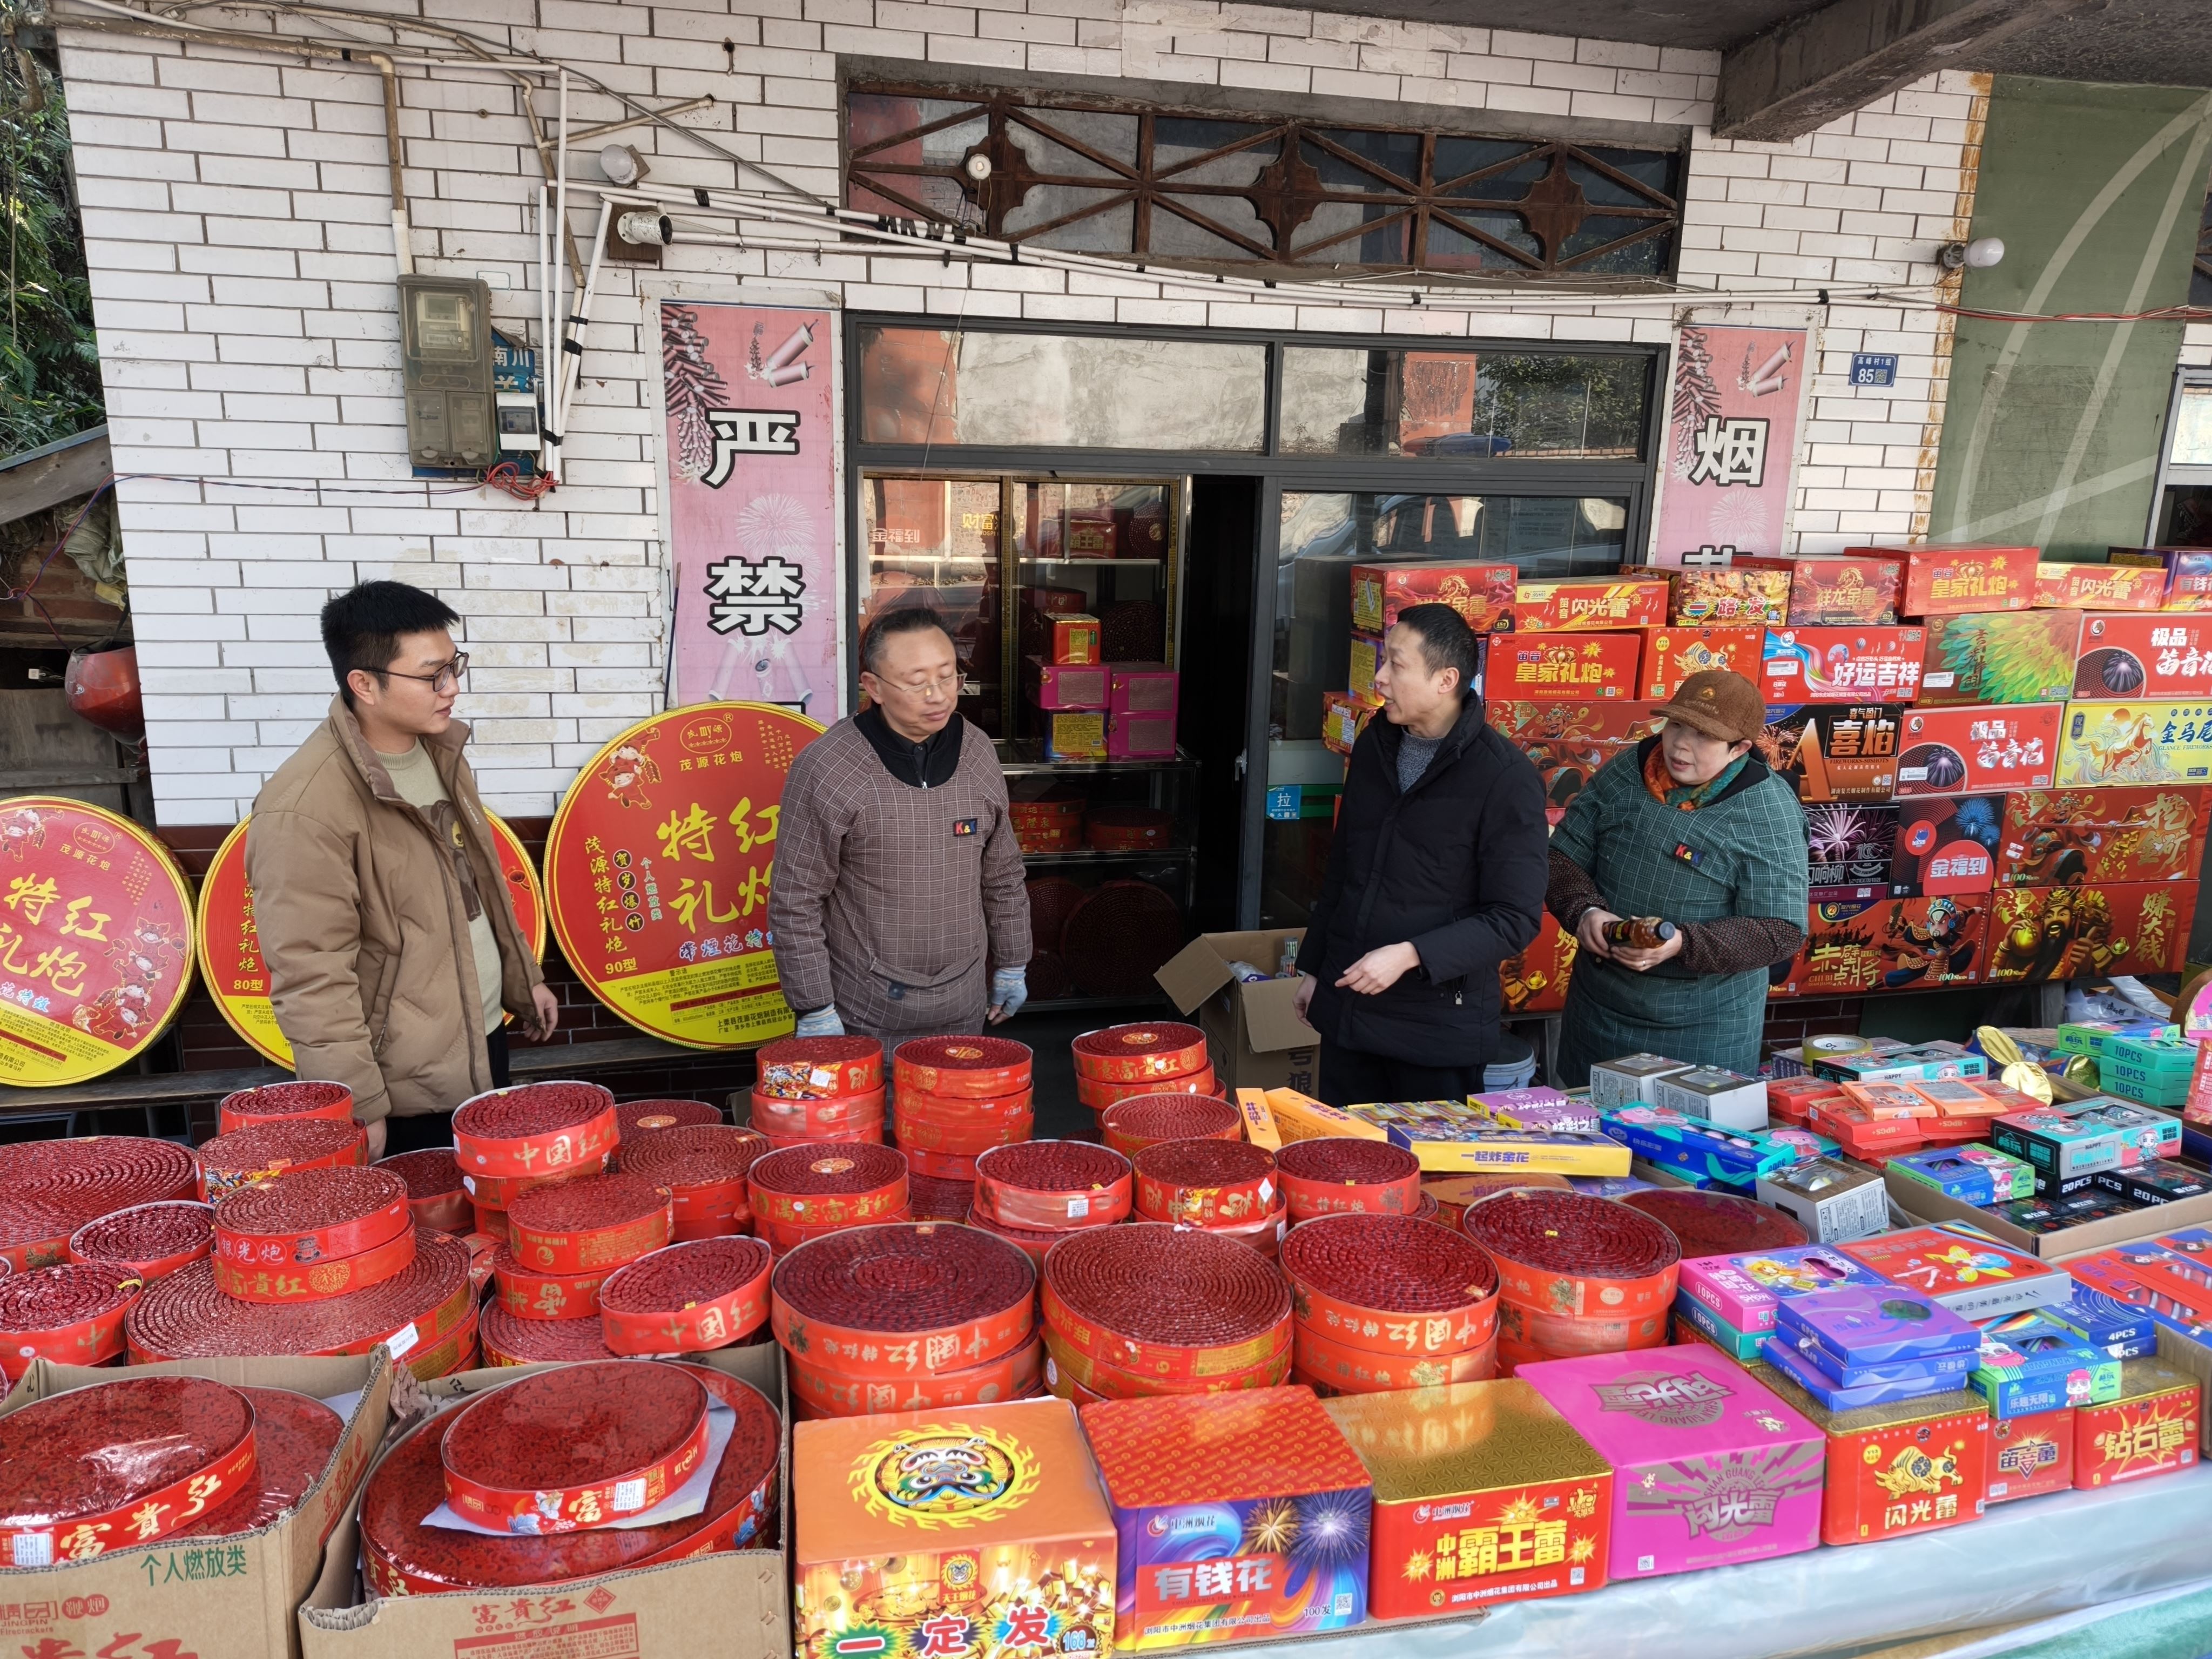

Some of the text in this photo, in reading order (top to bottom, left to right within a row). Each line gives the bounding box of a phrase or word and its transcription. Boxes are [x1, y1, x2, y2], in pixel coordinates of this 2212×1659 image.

[1858, 357, 1891, 366] 高峰村1组
[1858, 368, 1874, 383] 85
[701, 409, 806, 636] 严禁
[1932, 567, 1954, 578] 笛音
[1930, 575, 2008, 599] 皇家礼炮
[2069, 576, 2080, 597] 笛音
[1559, 597, 1569, 619] 笛音
[1572, 597, 1631, 618] 闪光蕾
[1689, 596, 1767, 616] 一路发
[2150, 628, 2187, 647] 极品
[1517, 650, 1541, 662] 笛音
[1515, 662, 1602, 683] 皇家礼炮
[1832, 662, 1921, 686] 好运吉祥
[1849, 707, 1883, 719] 喜气盈门
[1830, 719, 1896, 756] 喜焰
[1970, 720, 2006, 740] 极品
[679, 751, 743, 772] 茂源花炮
[1277, 793, 1292, 807] 拉
[656, 797, 781, 862] 特红
[955, 820, 976, 834] K&K
[1675, 844, 1702, 864] K&K
[1930, 856, 1988, 878] 金福到
[615, 851, 643, 930] 贺岁爆竹
[640, 857, 663, 921] 个人燃放类
[4, 873, 112, 942] 特红
[2133, 887, 2176, 969] 赚大钱
[605, 957, 638, 975] 90型
[233, 979, 264, 992] 80型
[2114, 1045, 2143, 1063] 10PCS
[2114, 1064, 2146, 1082] 10PCS
[2114, 1081, 2144, 1098] 10PCS
[513, 1134, 601, 1170] 中国红
[2061, 1175, 2092, 1193] 20PCS
[1697, 1283, 1721, 1309] 10PCS
[660, 1299, 758, 1345] 中国红
[1694, 1309, 1716, 1334] 10PCS
[2108, 1328, 2136, 1341] 4PCS
[2104, 1417, 2185, 1462] 钻石蕾
[1726, 1467, 1755, 1481] GUANG
[1432, 1502, 1472, 1516] 中洲烟花
[1884, 1494, 1958, 1530] 闪光蕾
[1434, 1533, 1457, 1581] 中洲
[1458, 1519, 1567, 1578] 霸王蕾
[140, 1544, 247, 1587] 个人燃放类
[1154, 1556, 1273, 1602] 有钱花
[1451, 1579, 1558, 1603] 浏阳市中洲烟花集团有限公司出品
[65, 1597, 105, 1616] 鞭炮
[1303, 1604, 1332, 1617] 100发
[836, 1604, 1051, 1657] 一定发
[1144, 1613, 1271, 1636] 浏阳市中洲烟花集团有限公司出品
